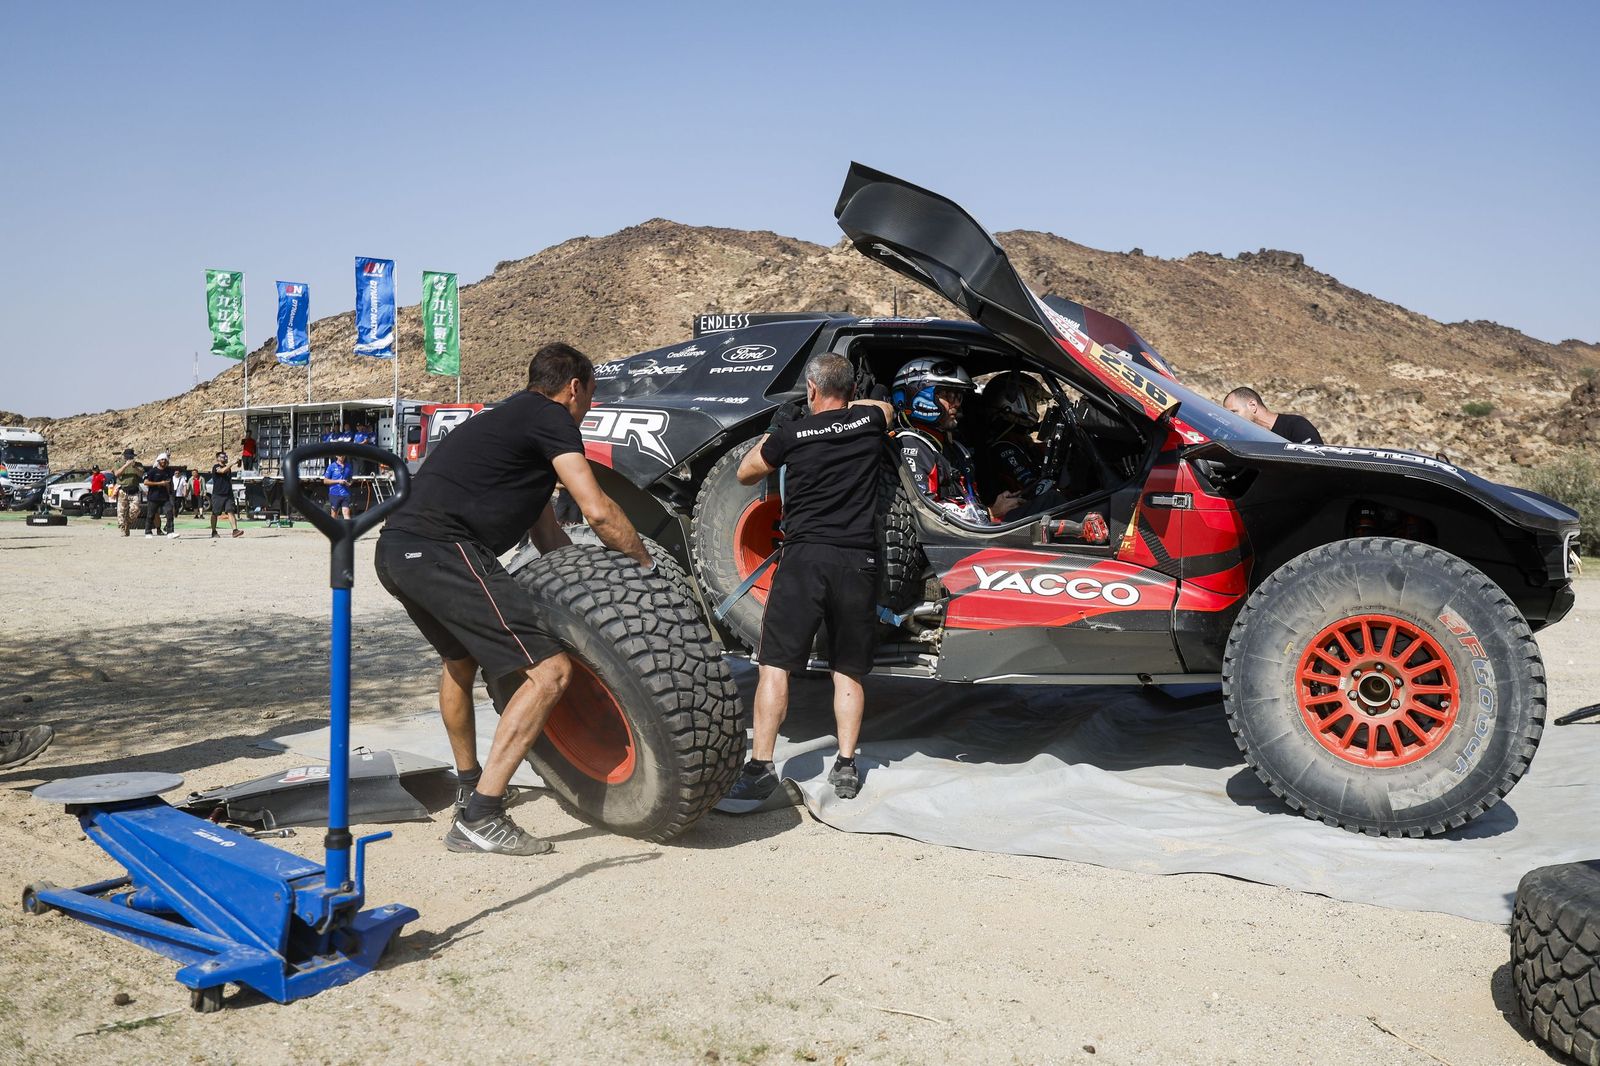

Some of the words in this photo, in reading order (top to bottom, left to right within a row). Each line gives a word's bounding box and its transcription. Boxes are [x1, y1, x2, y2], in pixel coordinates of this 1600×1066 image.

[701, 313, 750, 331] ENDLESS
[730, 346, 767, 360] Ford
[709, 364, 774, 374] RACING
[1099, 349, 1168, 407] 236
[796, 426, 832, 439] BENSON
[843, 416, 871, 431] CHERRY
[1283, 442, 1467, 482] RAPTOR
[972, 564, 1141, 607] YACCO
